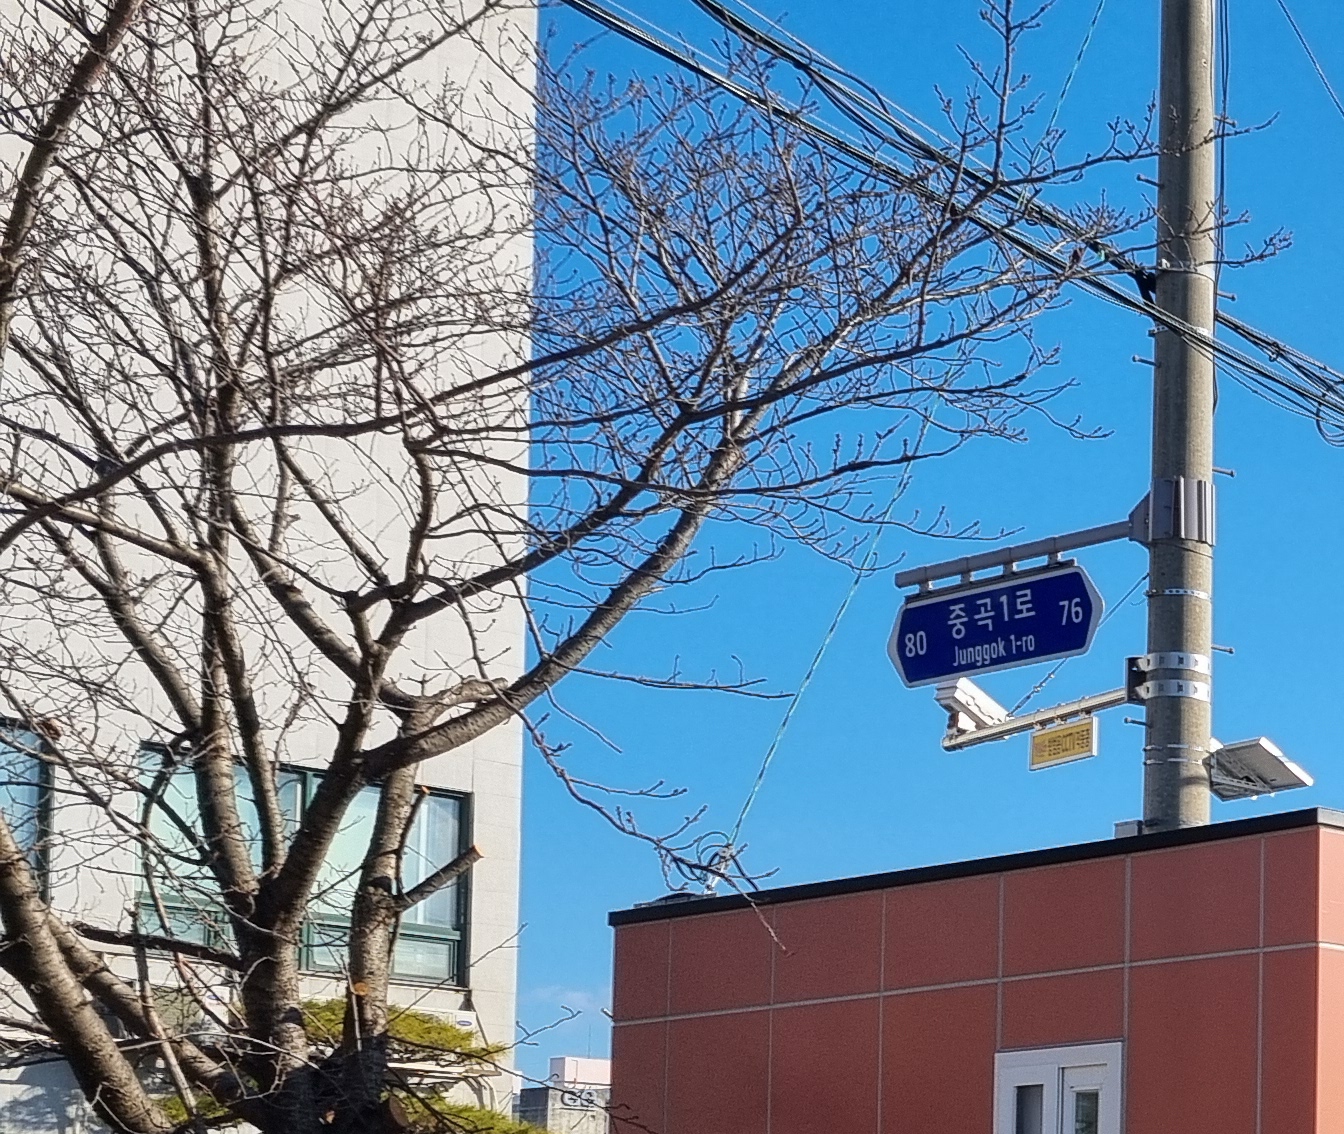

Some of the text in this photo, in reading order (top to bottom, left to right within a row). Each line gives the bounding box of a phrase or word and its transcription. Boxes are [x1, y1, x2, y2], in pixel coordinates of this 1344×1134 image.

[946, 588, 1036, 640] 중곡1로
[1059, 597, 1084, 626] 76
[905, 630, 928, 658] 80
[953, 634, 1036, 667] Junggok 1-ro
